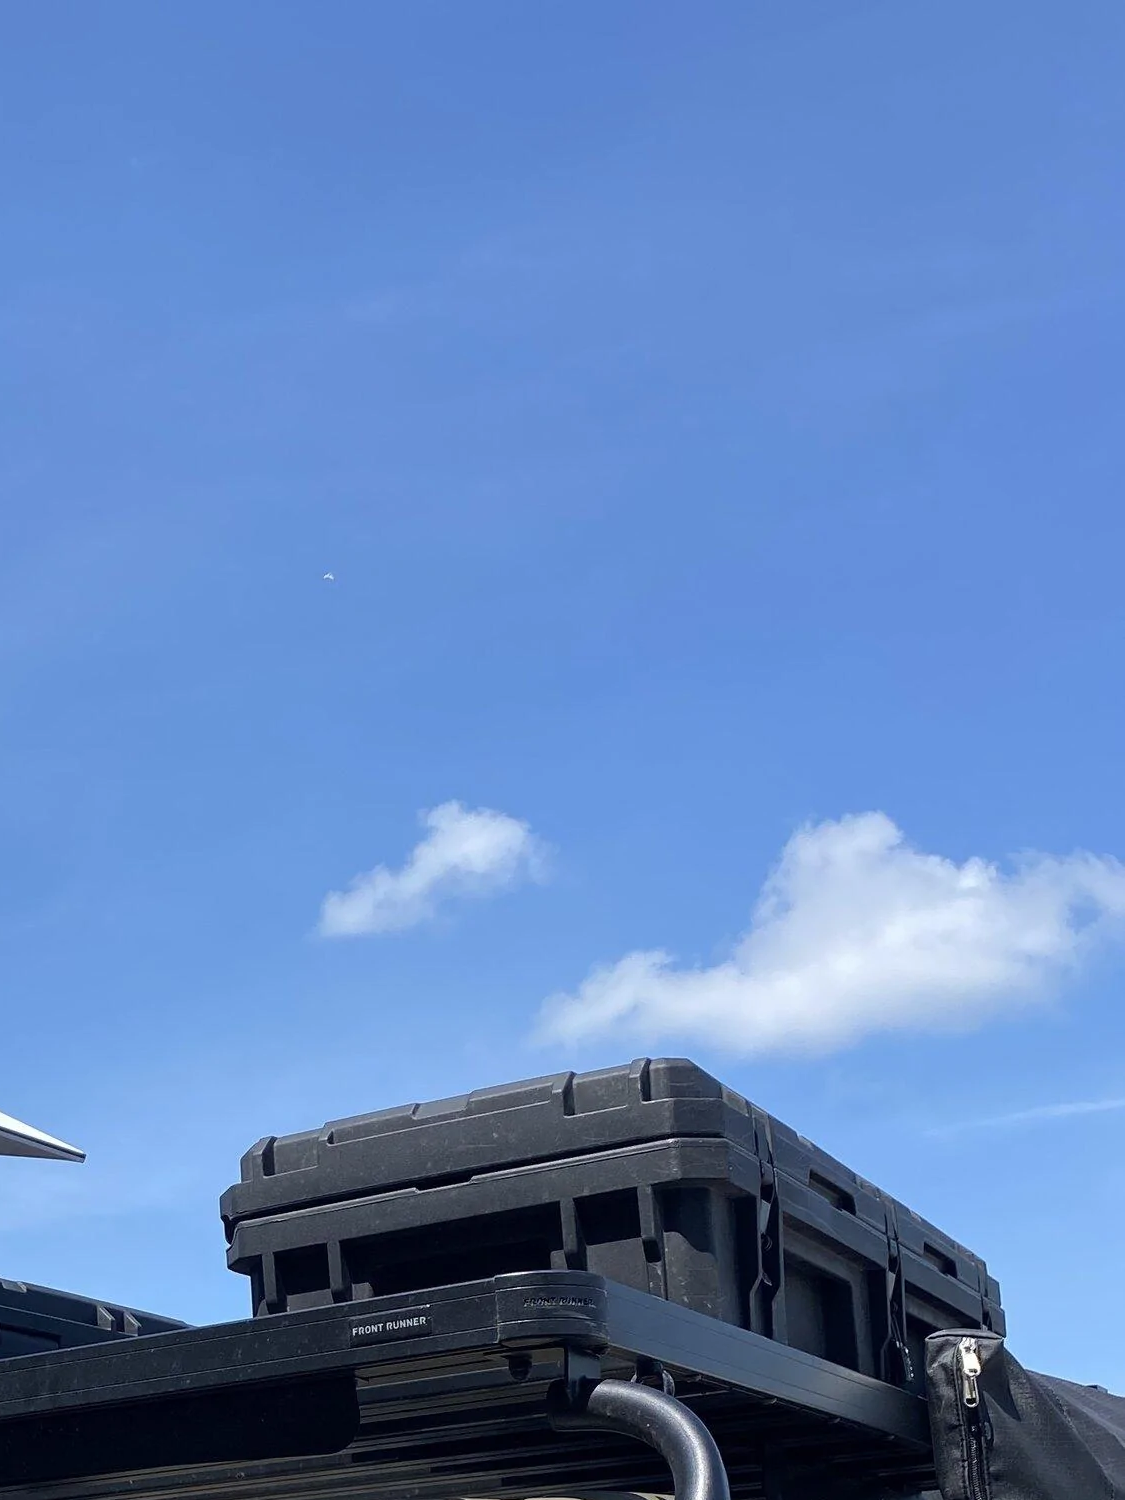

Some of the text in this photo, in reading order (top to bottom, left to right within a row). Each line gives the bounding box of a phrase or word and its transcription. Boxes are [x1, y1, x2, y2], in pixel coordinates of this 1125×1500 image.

[522, 1296, 556, 1308] FRONT
[352, 1316, 427, 1336] FRONT RUNNER
